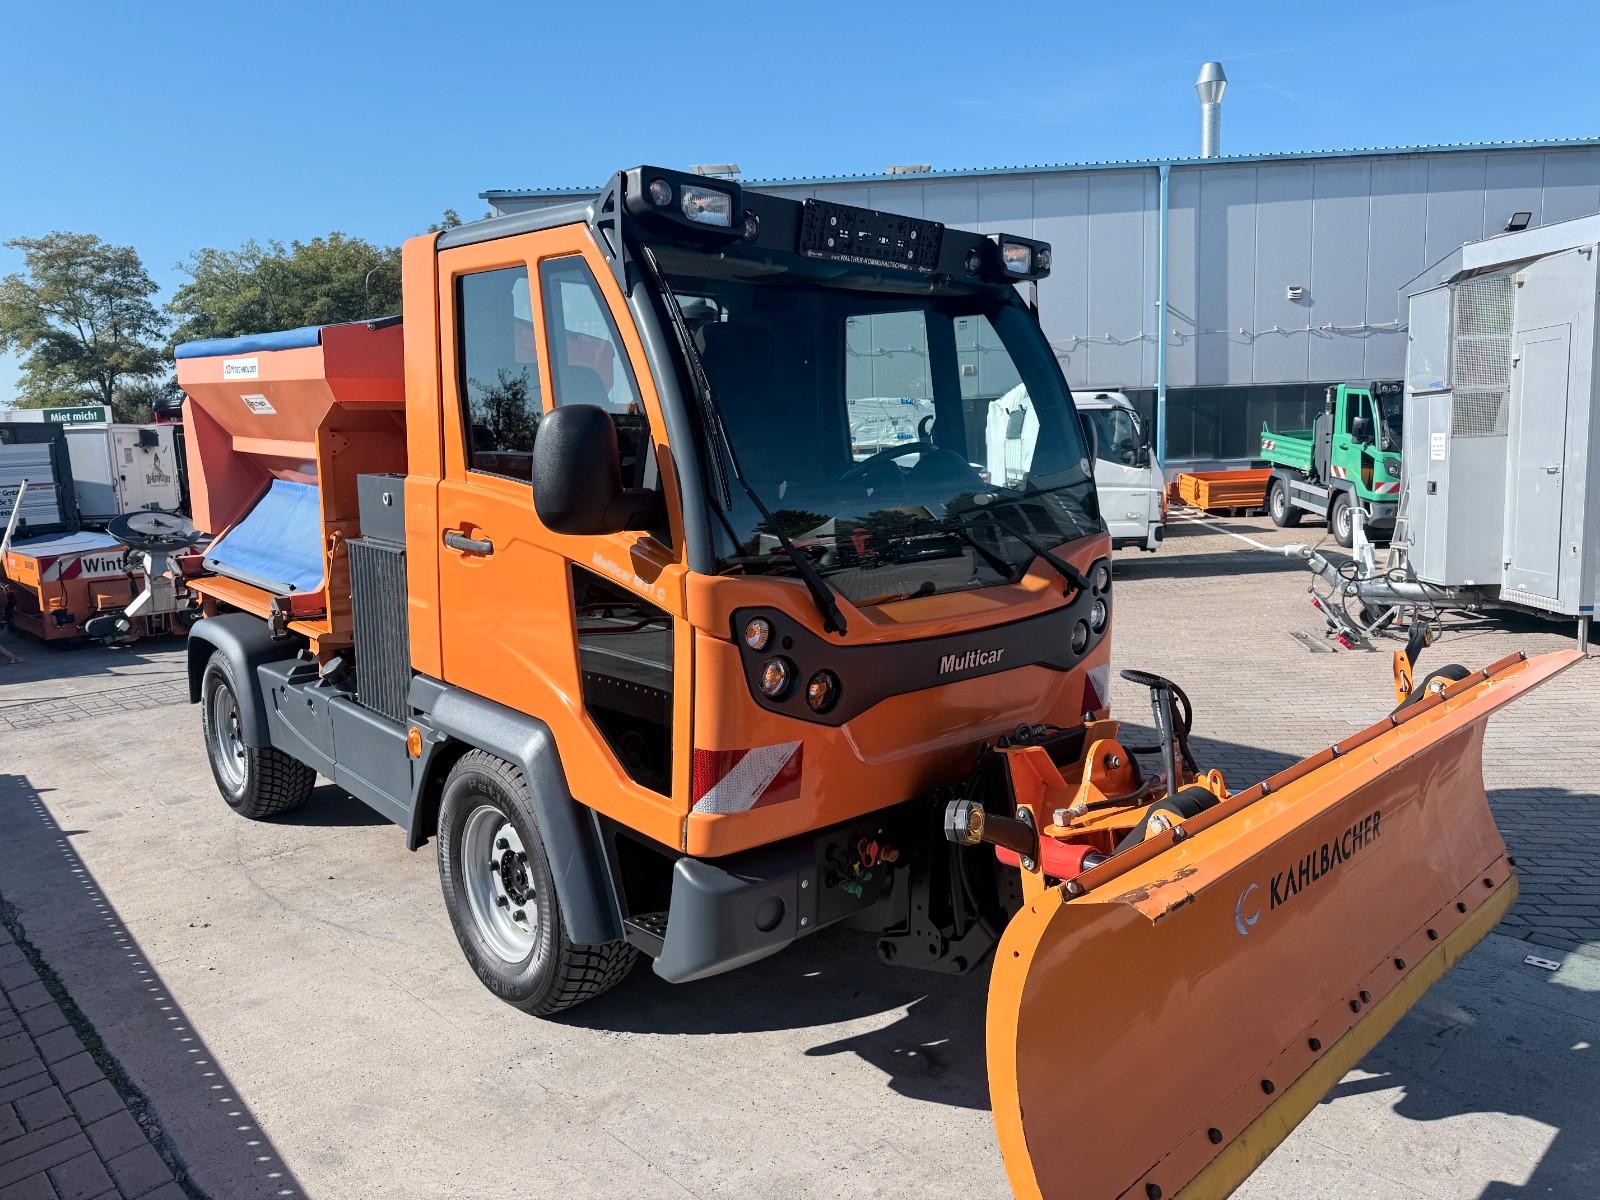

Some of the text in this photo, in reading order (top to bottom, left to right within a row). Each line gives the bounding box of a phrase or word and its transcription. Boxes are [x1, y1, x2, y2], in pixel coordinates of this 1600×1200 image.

[51, 411, 97, 422] Miet mich!
[939, 648, 1005, 675] Multicar
[1270, 810, 1381, 911] KAHLBACHER
